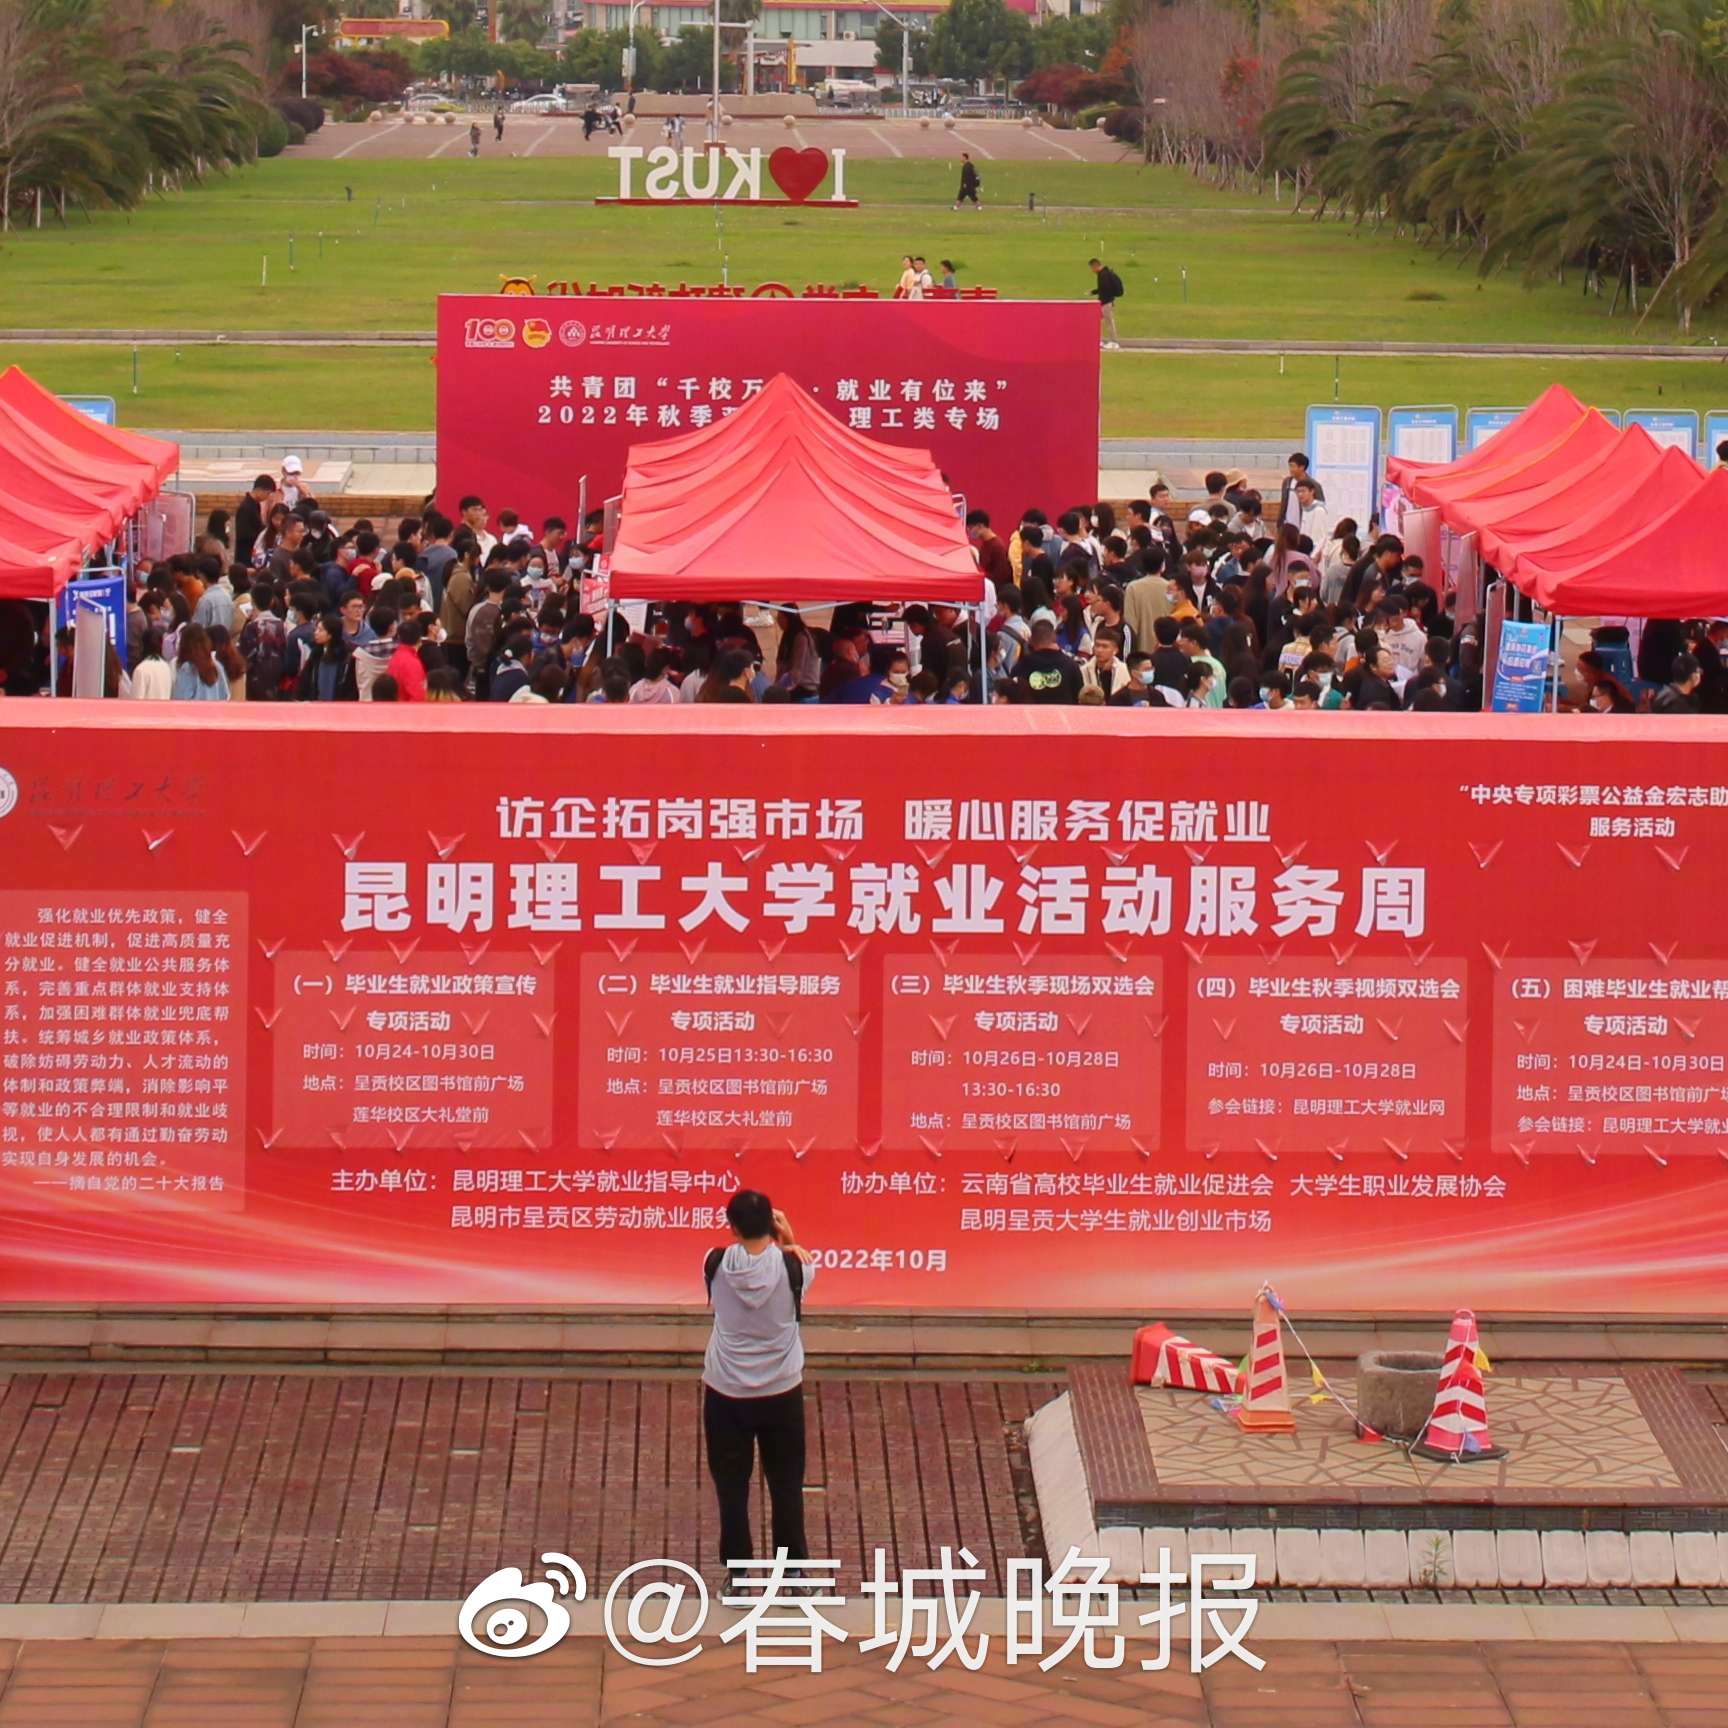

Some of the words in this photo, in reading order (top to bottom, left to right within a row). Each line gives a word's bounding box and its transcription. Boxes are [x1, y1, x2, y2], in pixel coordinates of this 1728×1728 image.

[550, 376, 1008, 403] 共青团“千校万·就业有位来”
[849, 407, 1000, 430] 理工类专场
[496, 795, 864, 841] 访企拓岗强市场
[903, 799, 1272, 844] 暖心服务促就业
[1589, 816, 1676, 838] 服务活动
[341, 861, 1427, 938] 昆明理工大学就业活动服务周
[294, 975, 537, 995] （一）毕业生就业政策宣传
[598, 975, 840, 995] （二）毕业生就业指导服务
[891, 975, 1155, 996] （三）毕业生秋季现场双选会
[1197, 978, 1460, 999] （四）毕业生秋季视频双选会
[367, 1011, 451, 1031] 专项活动
[671, 1011, 755, 1031] 专项活动
[974, 1011, 1058, 1032] 专项活动
[1280, 1014, 1364, 1034] 专项活动
[1584, 1015, 1668, 1036] 专项活动
[303, 1075, 524, 1092] 地点：呈贡校区图书馆前广场
[607, 1078, 828, 1095] 地点：呈贡校区图书馆前广场
[962, 1083, 1060, 1097] 13:30-16:30
[353, 1107, 489, 1123] 莲华校区大礼堂前
[1208, 1098, 1445, 1115] 参会链接：昆明理工大学就业网
[656, 1110, 792, 1127] 莲华校区大礼堂前
[911, 1113, 1130, 1130] 地点：呈贡校区图书馆前广场
[331, 1170, 740, 1193] 主办单位：昆明理工大学就业指导中心
[841, 1172, 1273, 1196] 协办单位：云南省高校毕业生就业促进会
[1290, 1174, 1506, 1198] 大学生职业发展协会
[960, 1209, 1271, 1233] 昆明呈贡大学生就业创业市场
[812, 1250, 946, 1271] 2022年10月
